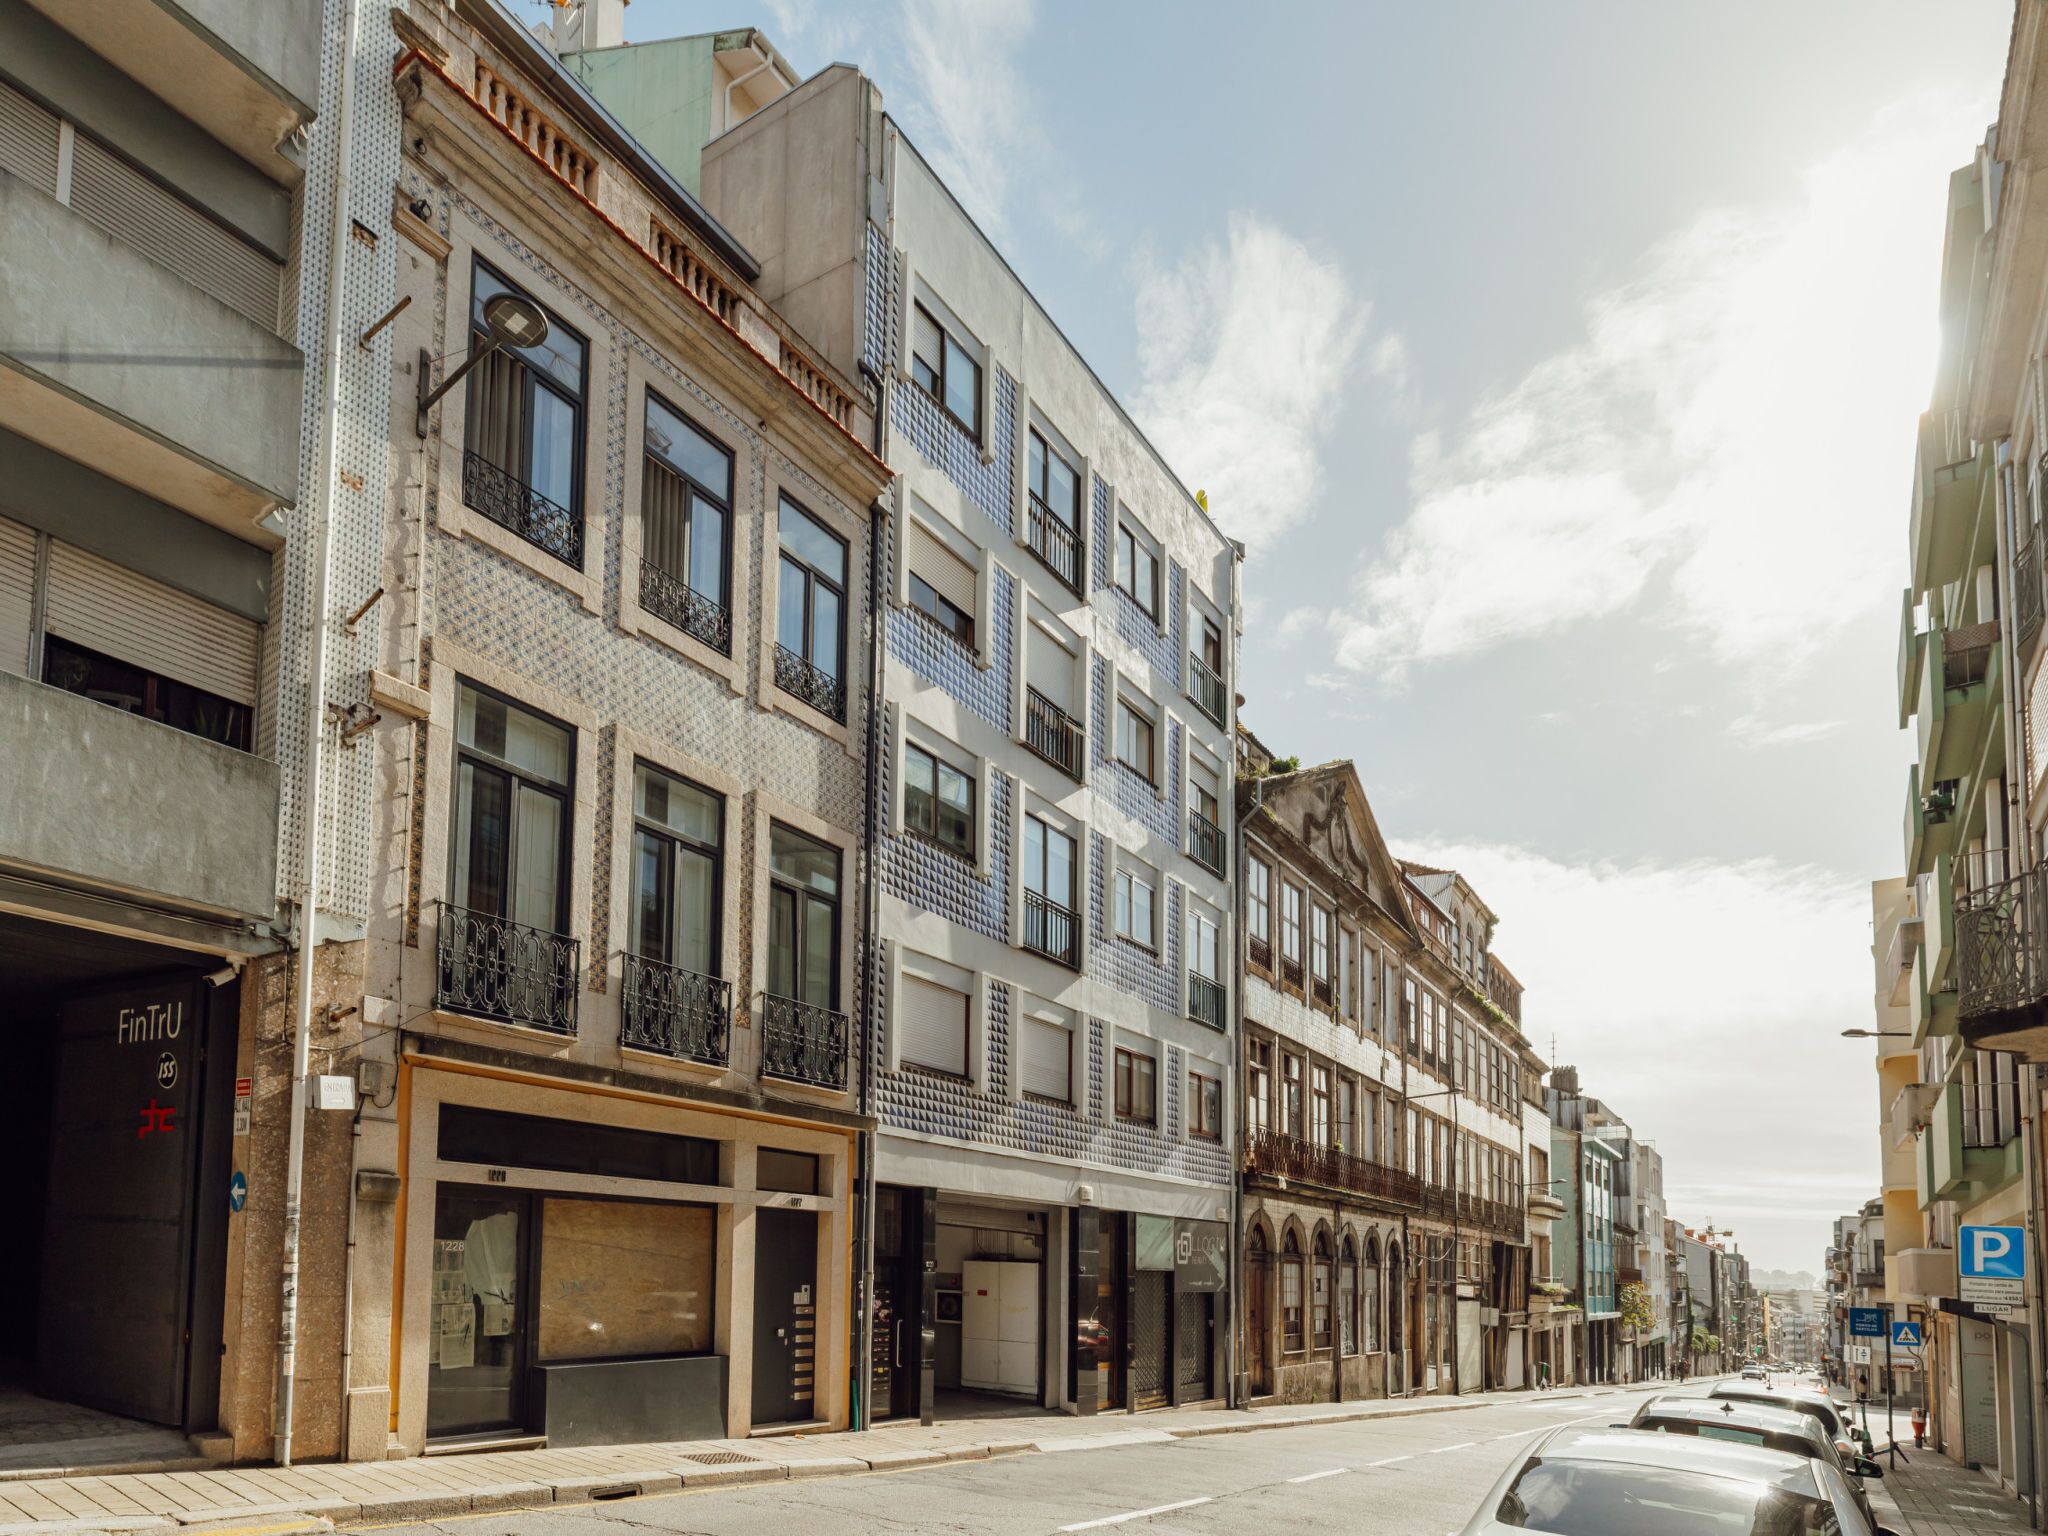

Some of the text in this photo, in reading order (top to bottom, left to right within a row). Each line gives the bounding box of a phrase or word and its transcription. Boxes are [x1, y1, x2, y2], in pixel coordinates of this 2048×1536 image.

[118, 1001, 182, 1044] FinTrU
[440, 1241, 465, 1252] 1228
[1973, 1231, 2010, 1272] P
